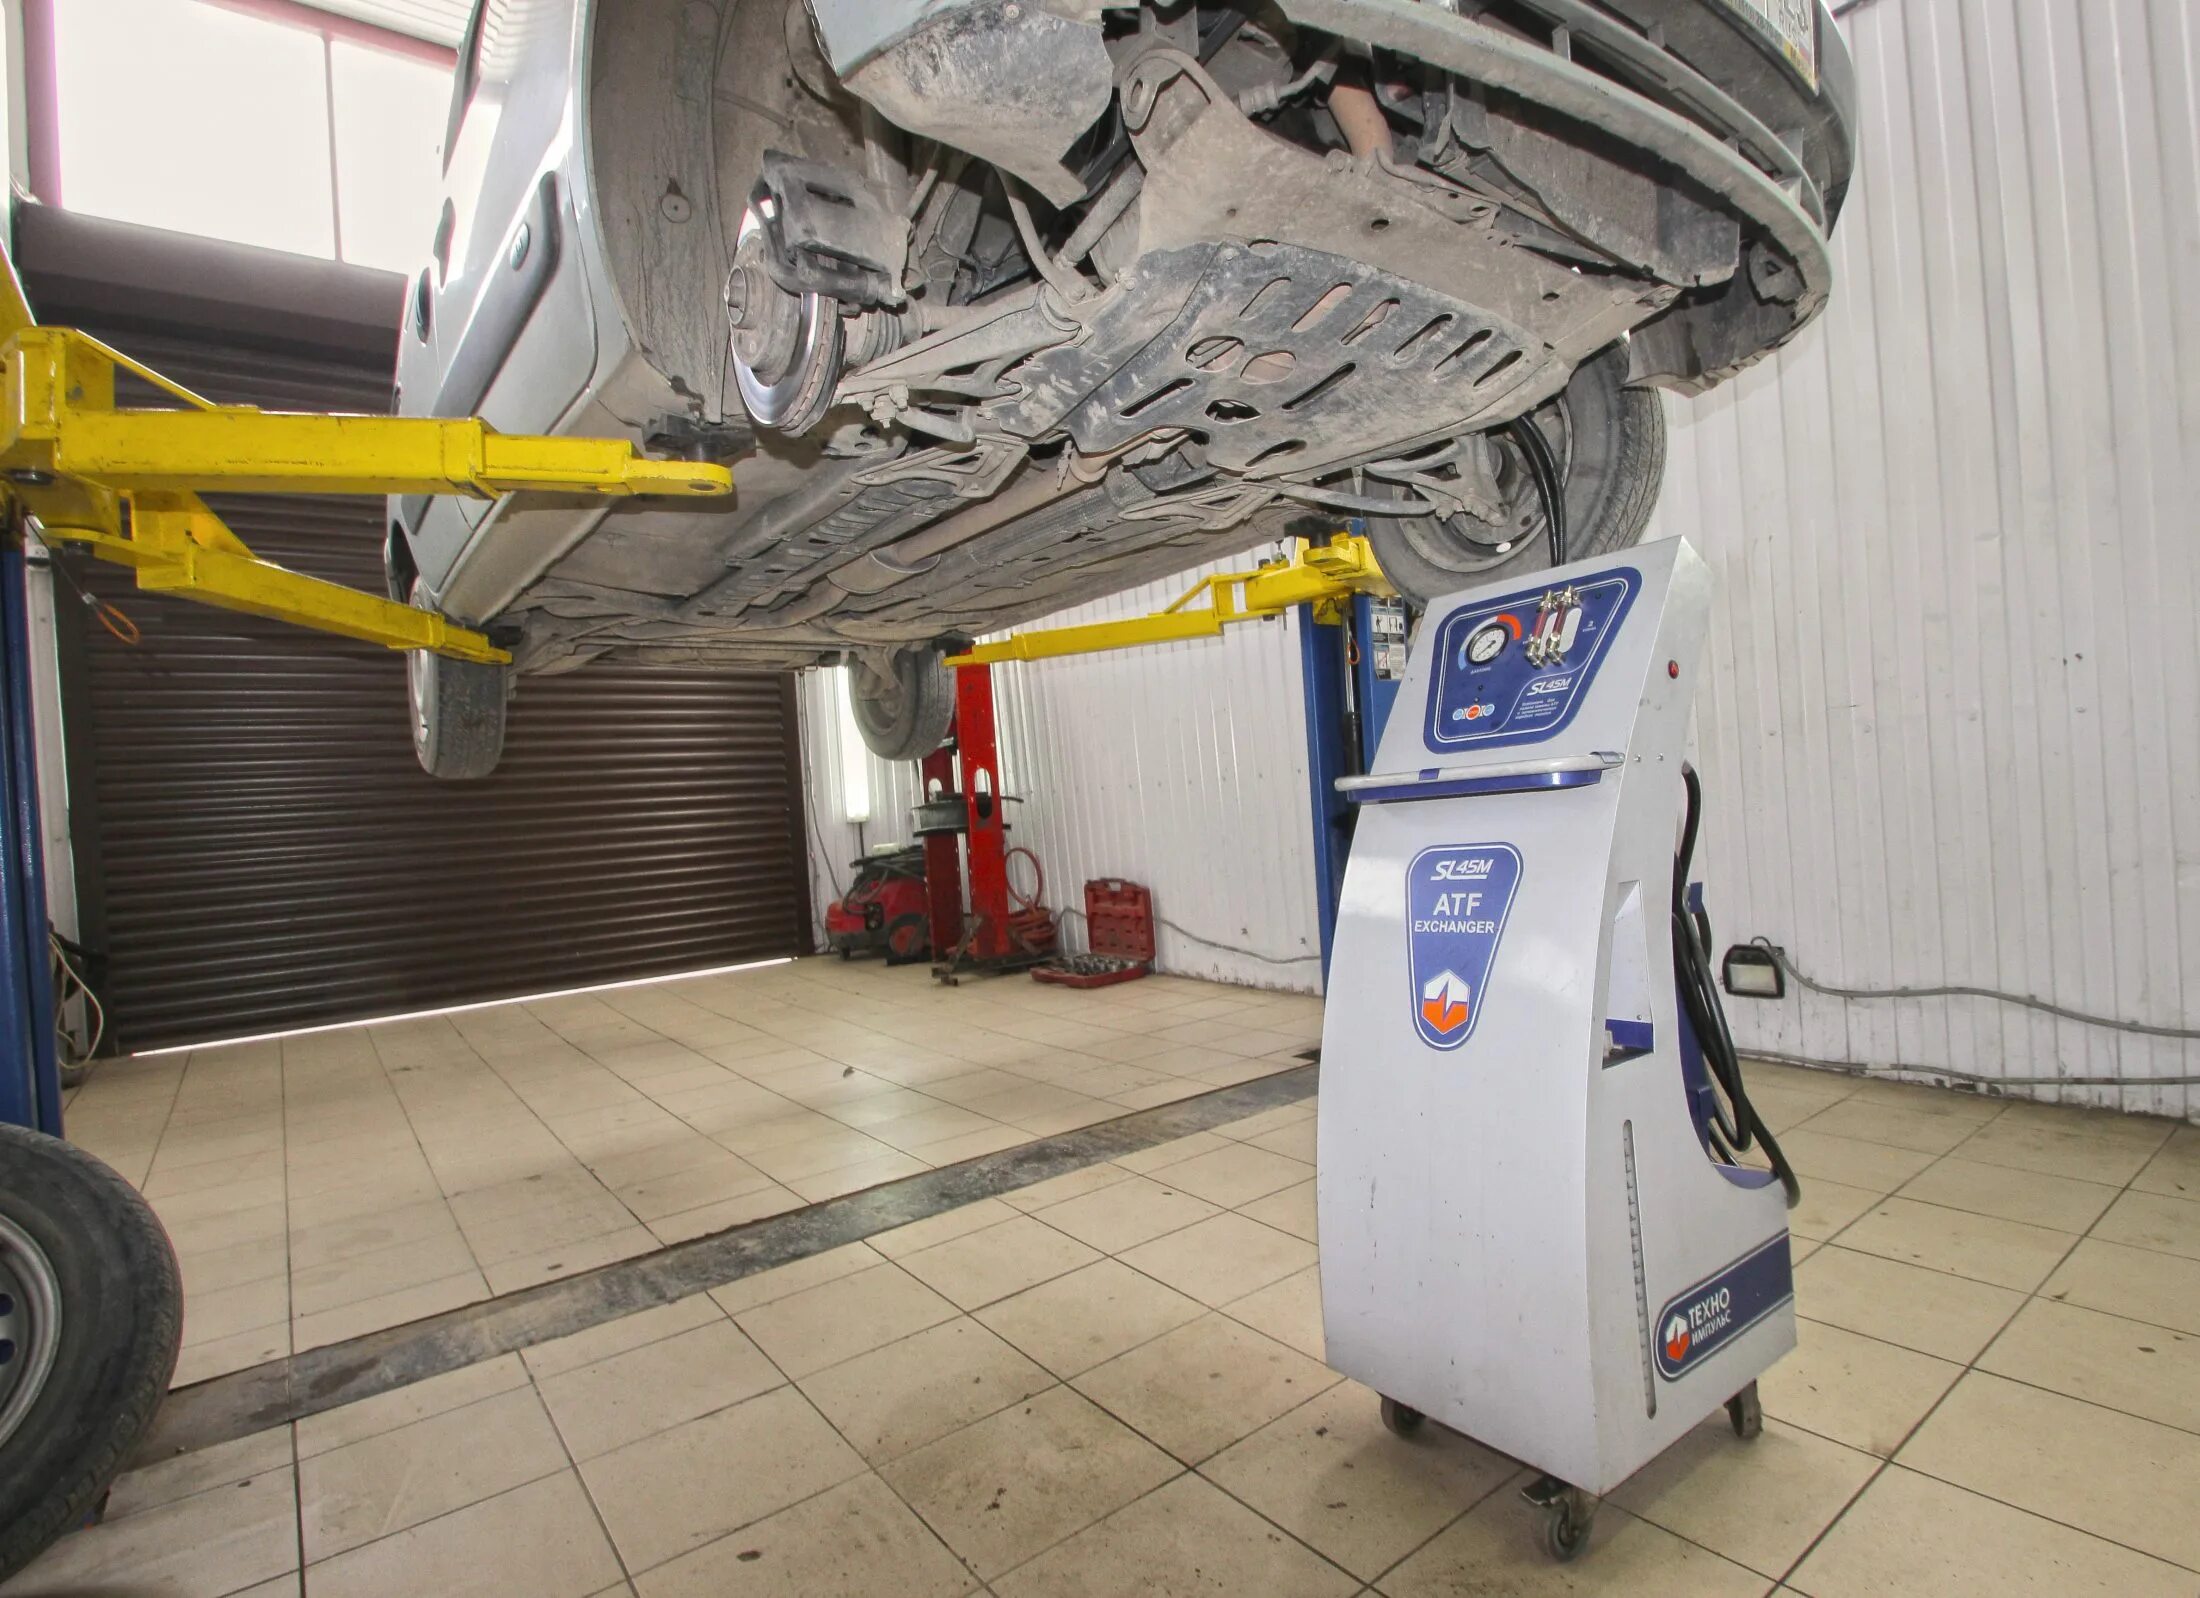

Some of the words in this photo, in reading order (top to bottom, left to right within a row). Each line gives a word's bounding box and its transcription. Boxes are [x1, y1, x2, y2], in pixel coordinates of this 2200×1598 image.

[1430, 859, 1494, 881] SL45M
[1433, 893, 1483, 916] ATF
[1414, 920, 1494, 934] EXCHANGER
[1688, 1287, 1730, 1329] ТЕХНО
[1691, 1310, 1732, 1347] ИМПУЛЬС
